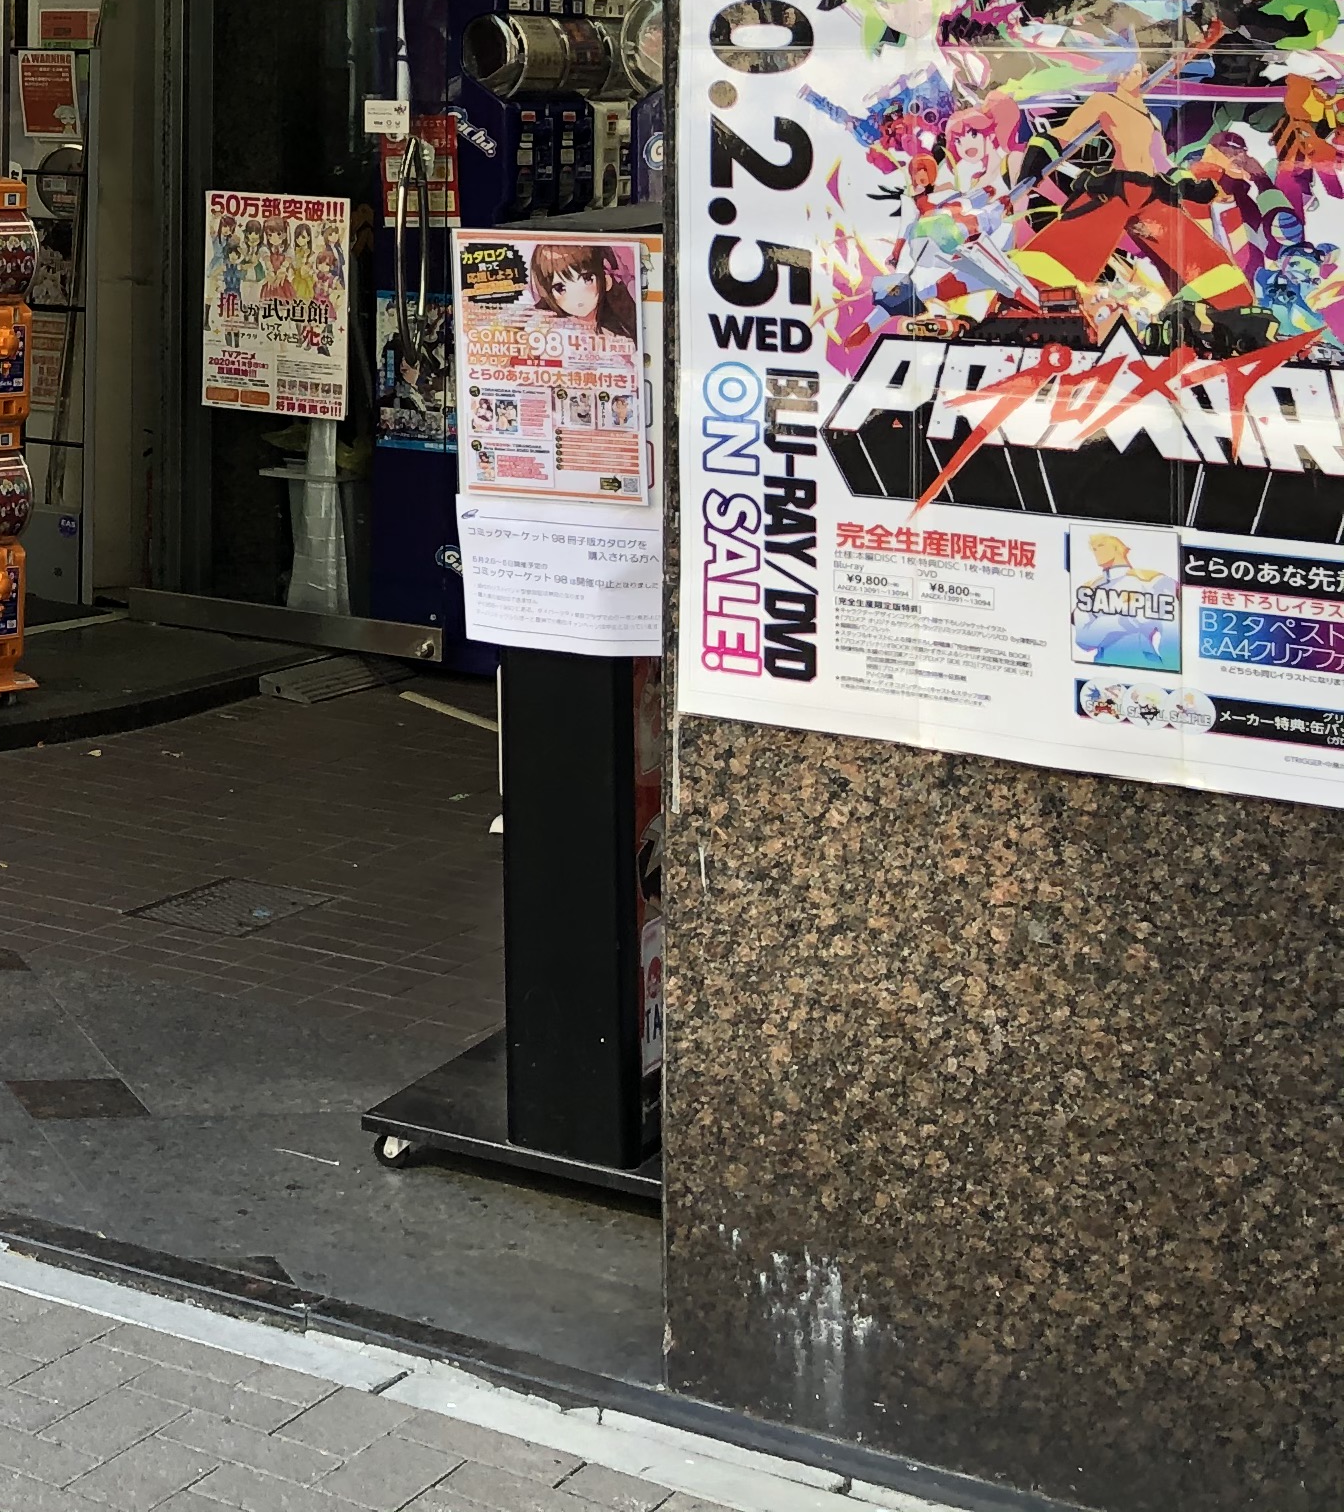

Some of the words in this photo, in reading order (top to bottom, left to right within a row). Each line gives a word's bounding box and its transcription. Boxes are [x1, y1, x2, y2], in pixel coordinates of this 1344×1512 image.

[30, 53, 72, 65] WARNING
[210, 193, 345, 224] 50万部突破!!!
[461, 247, 514, 265] カタログを
[261, 297, 330, 325] 武道館
[707, 313, 812, 354] WED
[467, 329, 528, 344] COMIC
[528, 330, 563, 358] 98
[468, 343, 527, 357] MARKET
[220, 349, 257, 360] TVアニメ
[468, 367, 637, 389] とらのあな10大特典付き!
[702, 360, 763, 478] ON
[467, 526, 550, 542] コミックマーケット
[551, 533, 566, 544] 98
[835, 521, 1037, 570] 完全生産限定版
[587, 550, 660, 564] 購入される方へ
[833, 560, 865, 572] Blu-ray
[472, 566, 552, 583] コミックマーケット
[553, 574, 568, 585] 98
[702, 488, 763, 678] SALE!
[846, 573, 888, 588] ¥9,800
[916, 569, 938, 580] DVD
[929, 582, 970, 597] ¥8,800
[1076, 587, 1175, 622] SAMPLE
[1169, 710, 1211, 727] SAMPLE
